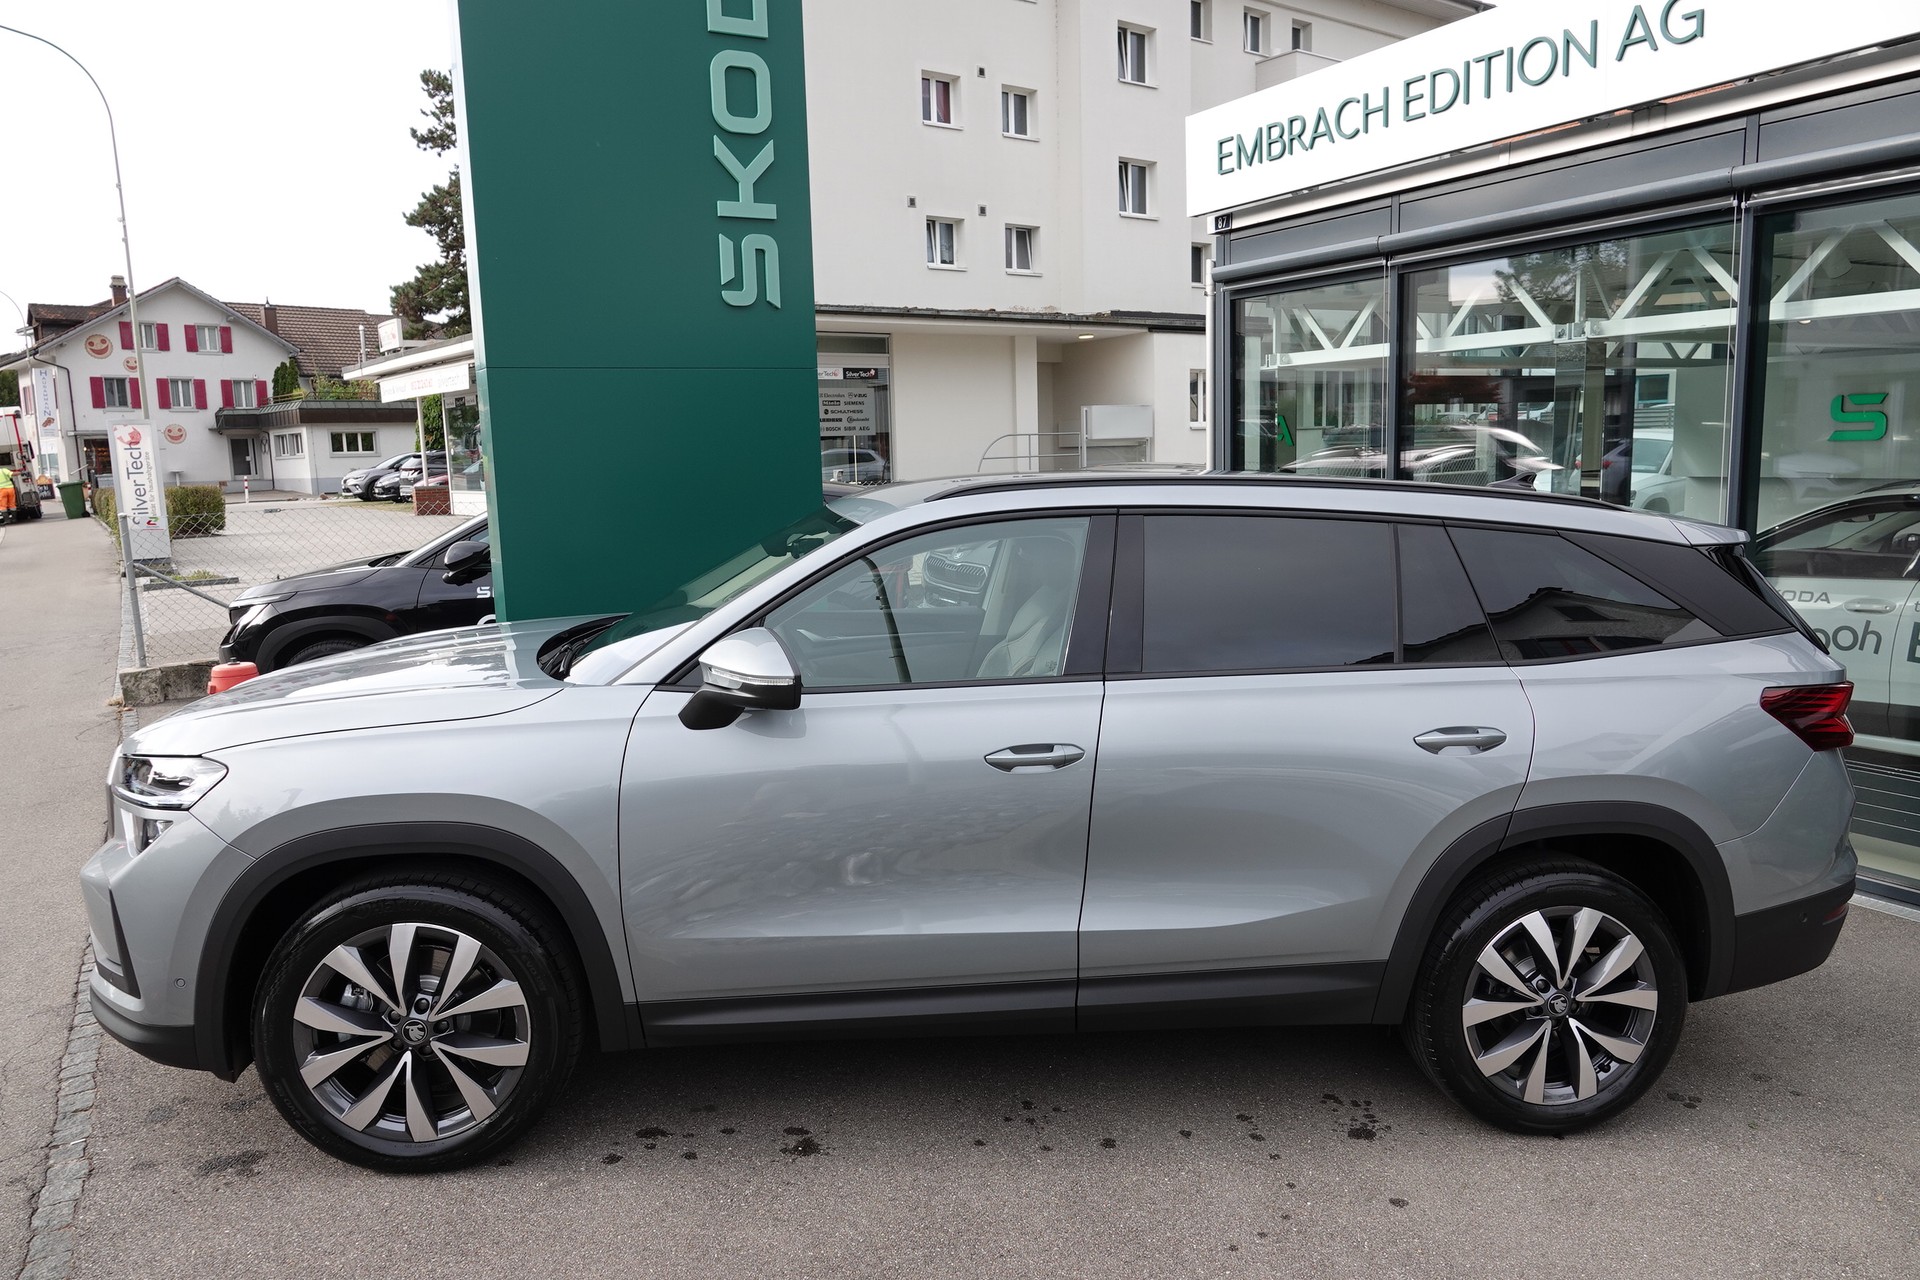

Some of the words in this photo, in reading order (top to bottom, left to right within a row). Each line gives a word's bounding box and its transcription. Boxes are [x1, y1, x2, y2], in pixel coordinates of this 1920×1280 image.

[1217, 86, 1389, 175] EMBRACH
[1403, 19, 1598, 122] EDITION
[1615, 0, 1706, 62] AG
[1217, 216, 1227, 229] 87
[124, 441, 144, 480] Tech
[1779, 589, 1831, 604] ODA
